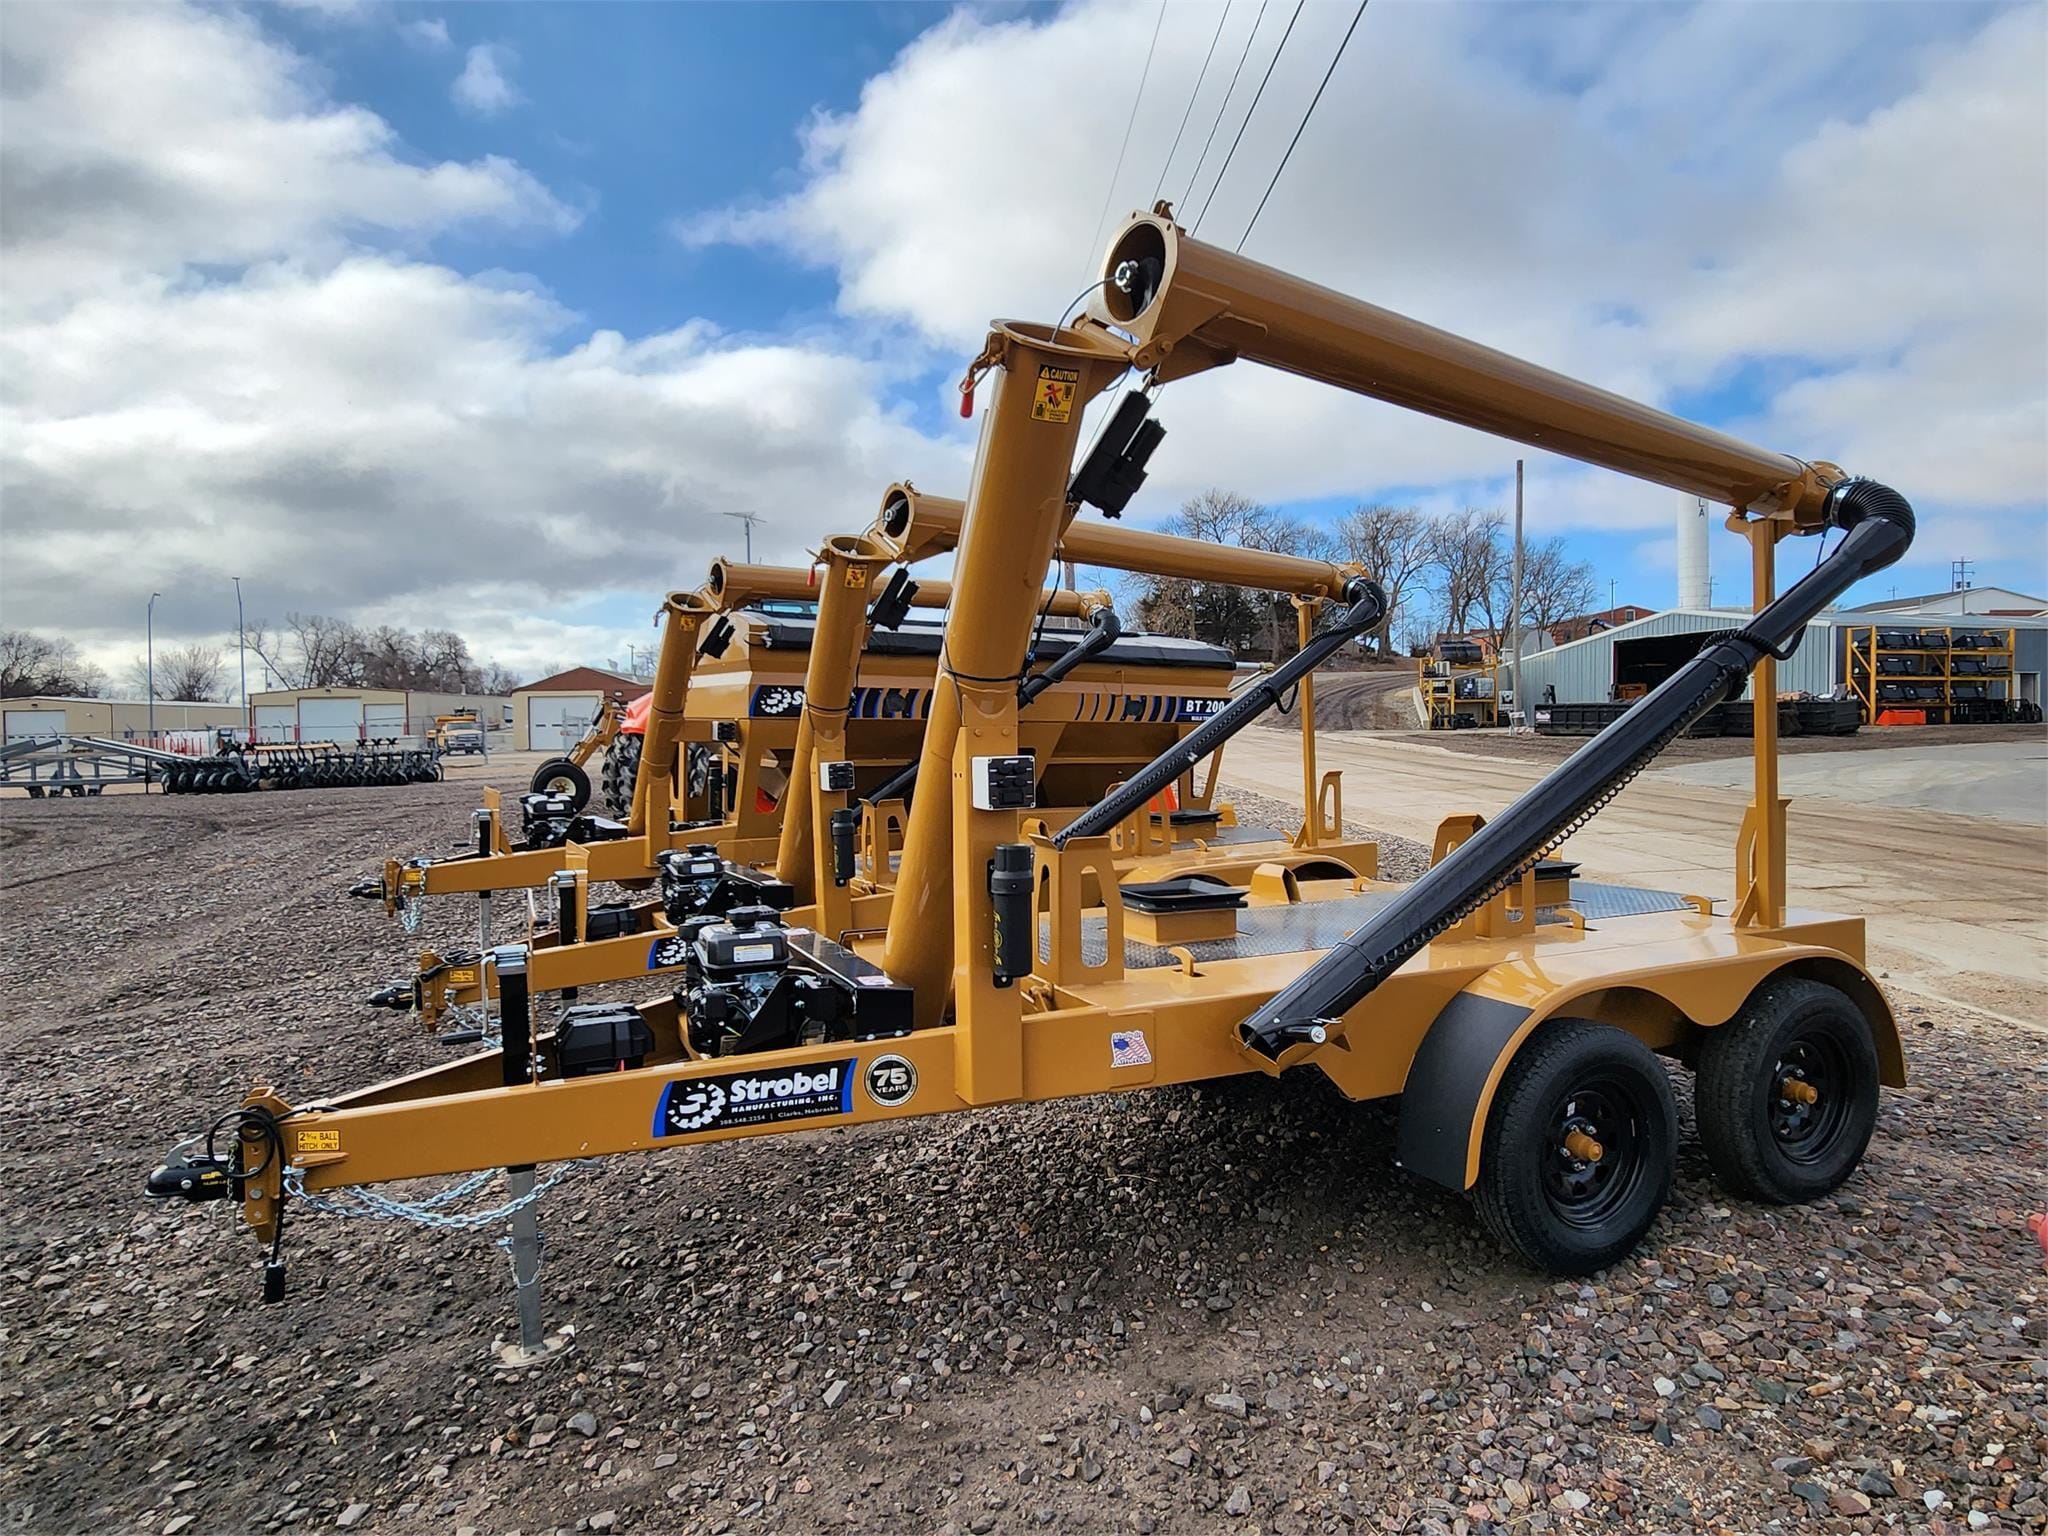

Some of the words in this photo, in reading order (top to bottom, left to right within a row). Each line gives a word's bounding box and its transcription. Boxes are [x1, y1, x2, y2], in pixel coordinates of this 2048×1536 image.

[1050, 369, 1078, 381] CAUTION
[1186, 700, 1203, 713] BT
[1114, 1056, 1150, 1065] America
[873, 1067, 907, 1087] 75
[730, 1067, 838, 1103] Strobel
[876, 1084, 909, 1093] YEARS
[731, 1097, 814, 1113] MANUFACTURING,
[817, 1094, 838, 1103] INC.
[804, 1105, 839, 1116] Nebraska
[319, 1132, 337, 1140] BALL
[299, 1142, 318, 1150] HITCH
[320, 1142, 338, 1150] ONLY
